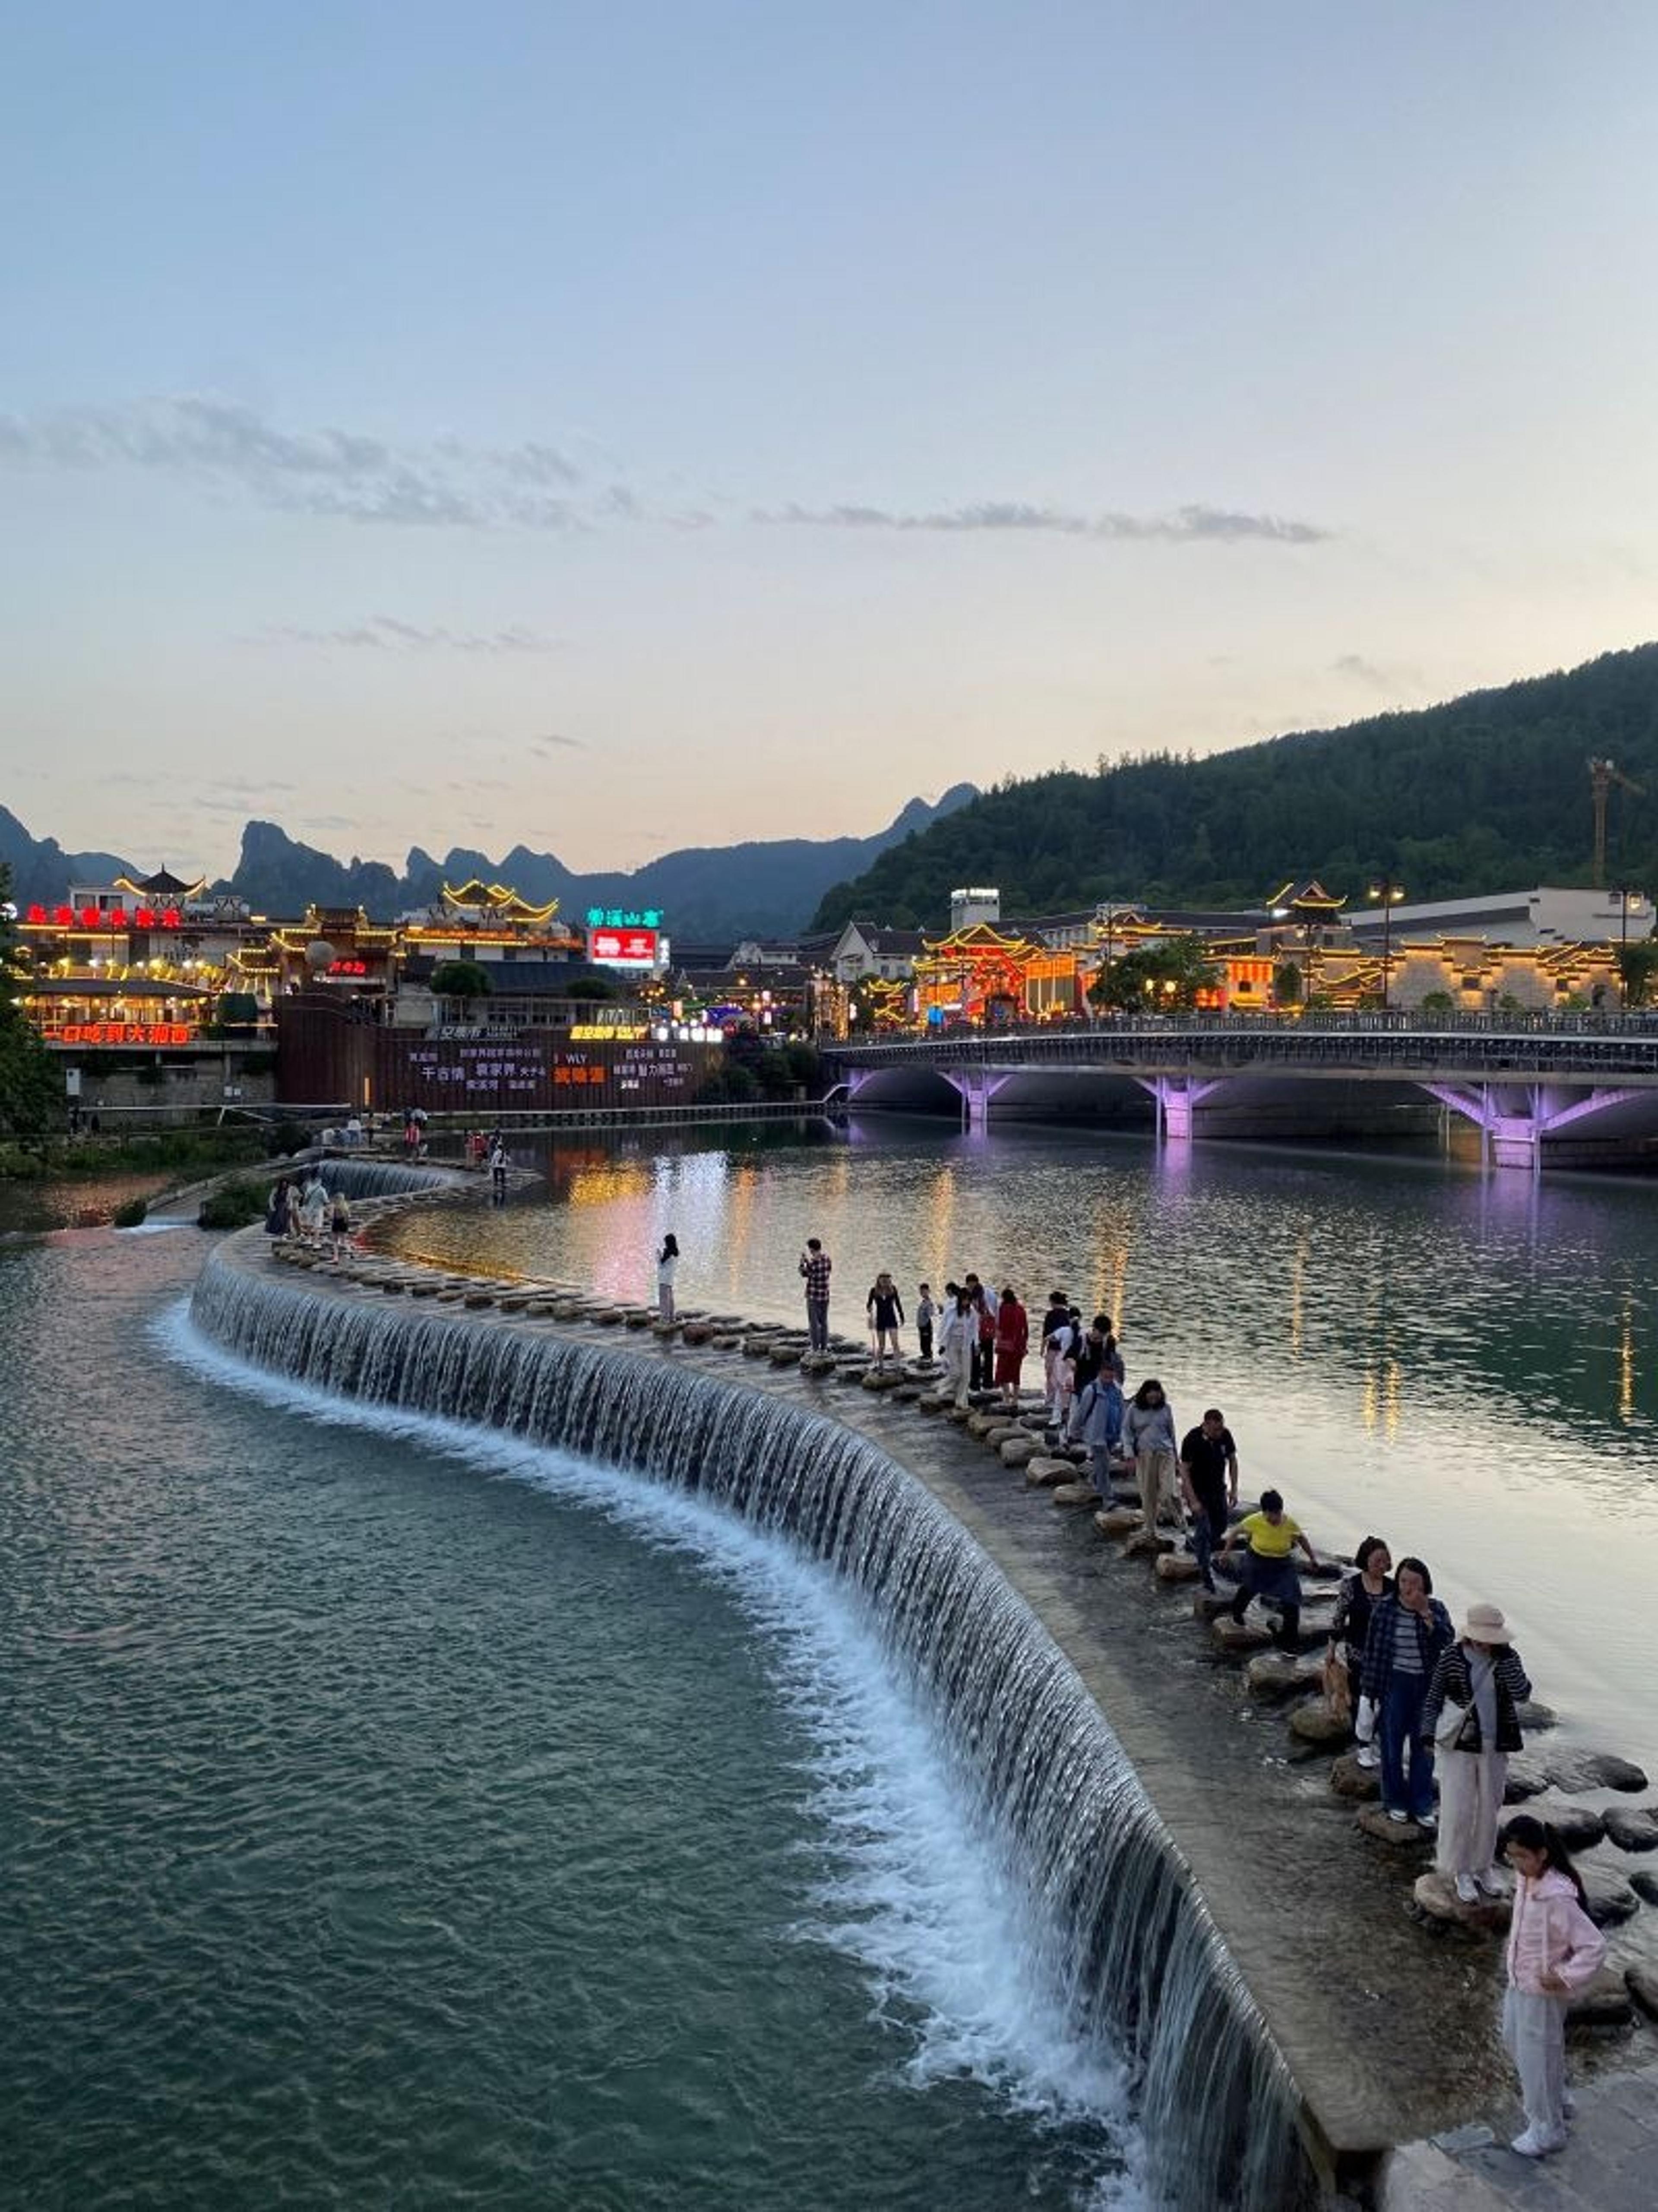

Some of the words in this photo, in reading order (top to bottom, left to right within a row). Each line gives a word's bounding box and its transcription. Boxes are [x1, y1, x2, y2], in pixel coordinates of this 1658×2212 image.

[44, 1025, 188, 1044] 一口吃到大湘西
[566, 1053, 587, 1064] WLY
[422, 1067, 465, 1081] 千古情
